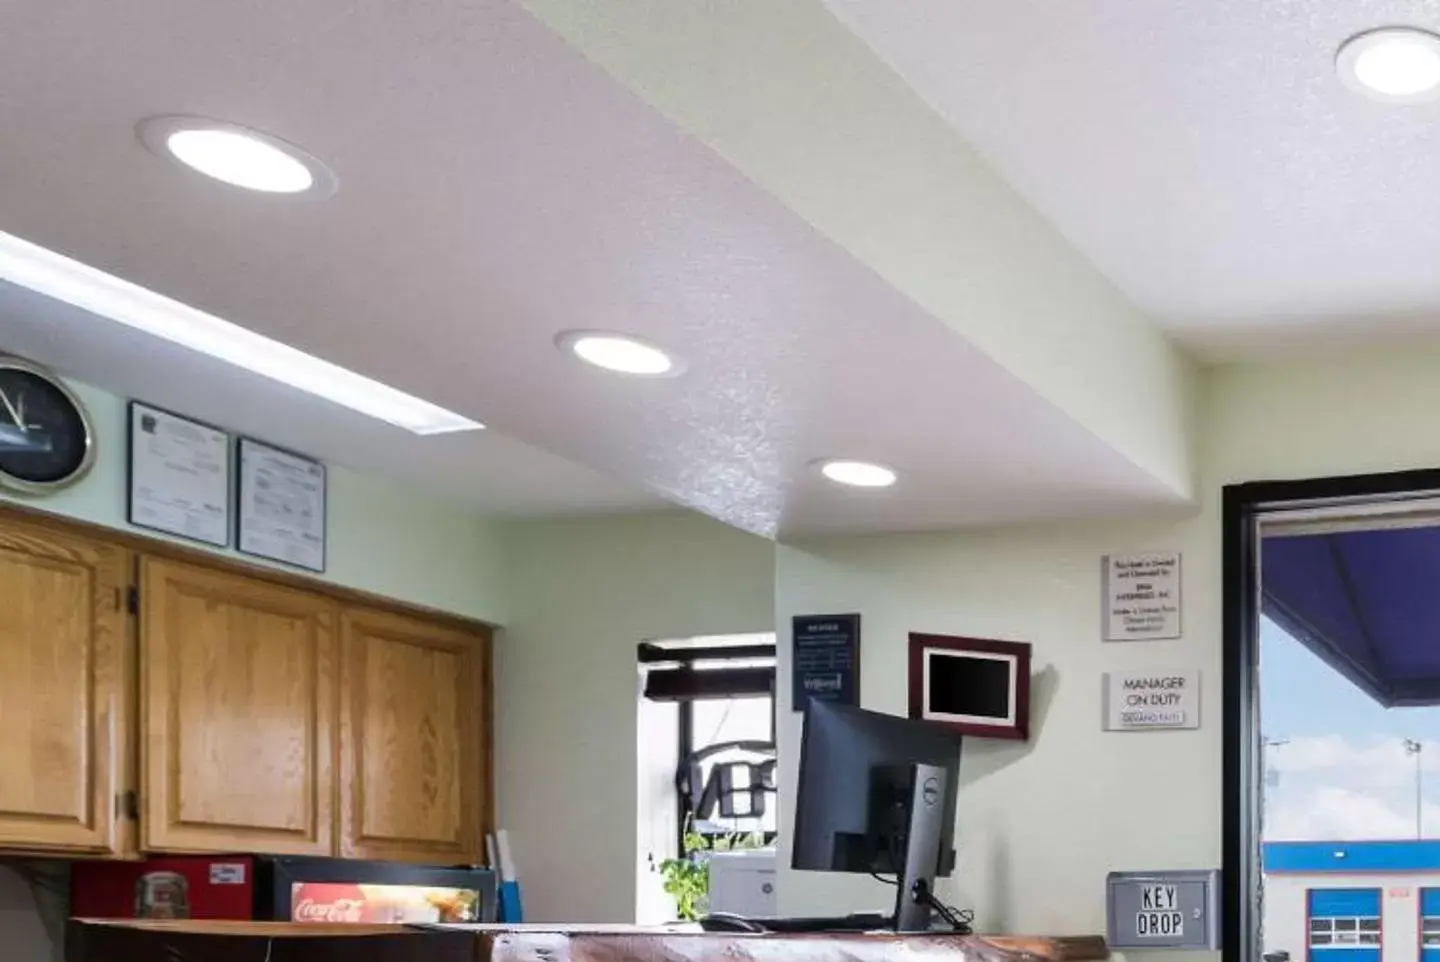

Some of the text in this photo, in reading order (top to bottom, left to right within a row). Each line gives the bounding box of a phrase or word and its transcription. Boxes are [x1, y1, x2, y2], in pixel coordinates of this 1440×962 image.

[1123, 677, 1186, 690] MANAGER
[1127, 693, 1181, 706] ON DUTY
[1143, 886, 1175, 909] KEY
[296, 898, 364, 922] Coca-Cola
[1138, 913, 1182, 935] DROP
